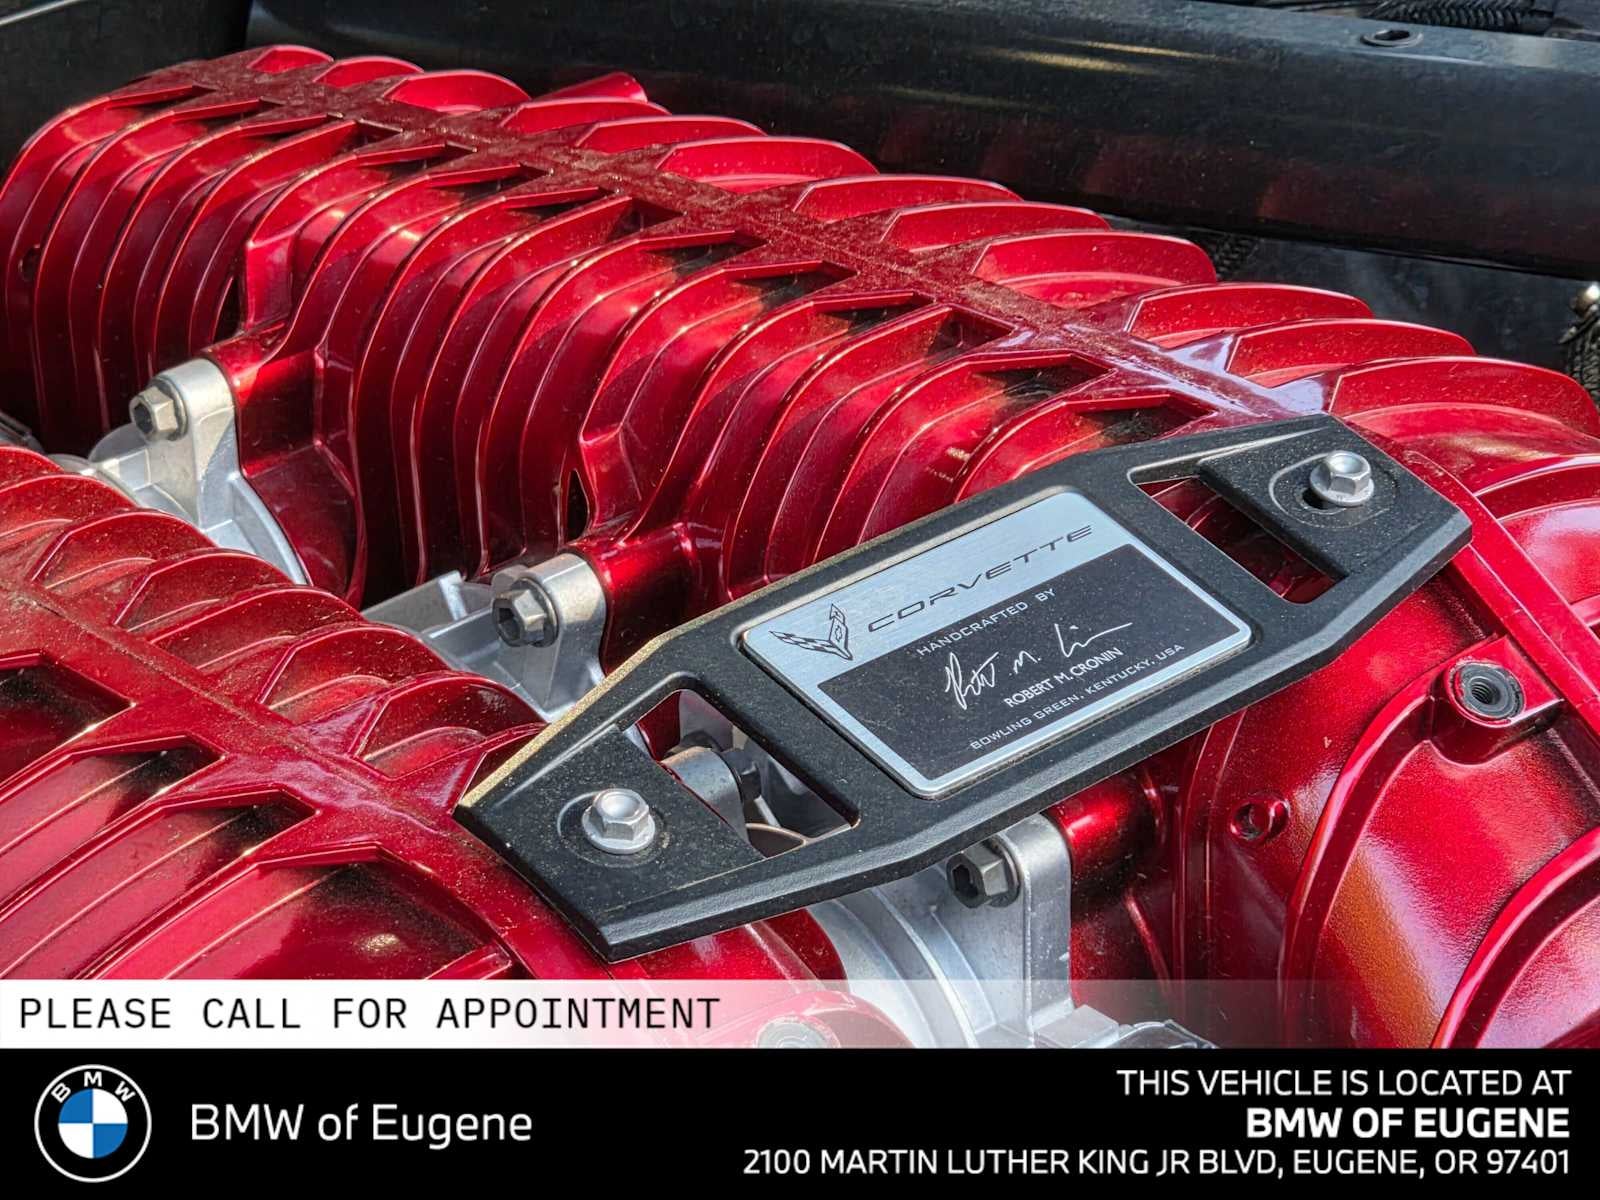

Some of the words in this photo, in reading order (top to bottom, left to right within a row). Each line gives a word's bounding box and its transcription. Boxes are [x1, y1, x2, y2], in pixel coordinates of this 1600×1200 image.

[867, 525, 1093, 633] CORVETTE
[916, 601, 1029, 657] HANDCRAFTED
[1034, 587, 1057, 603] BY
[969, 716, 1032, 750] BOWLING
[1155, 644, 1185, 661] USA
[1003, 678, 1055, 708] ROBERT
